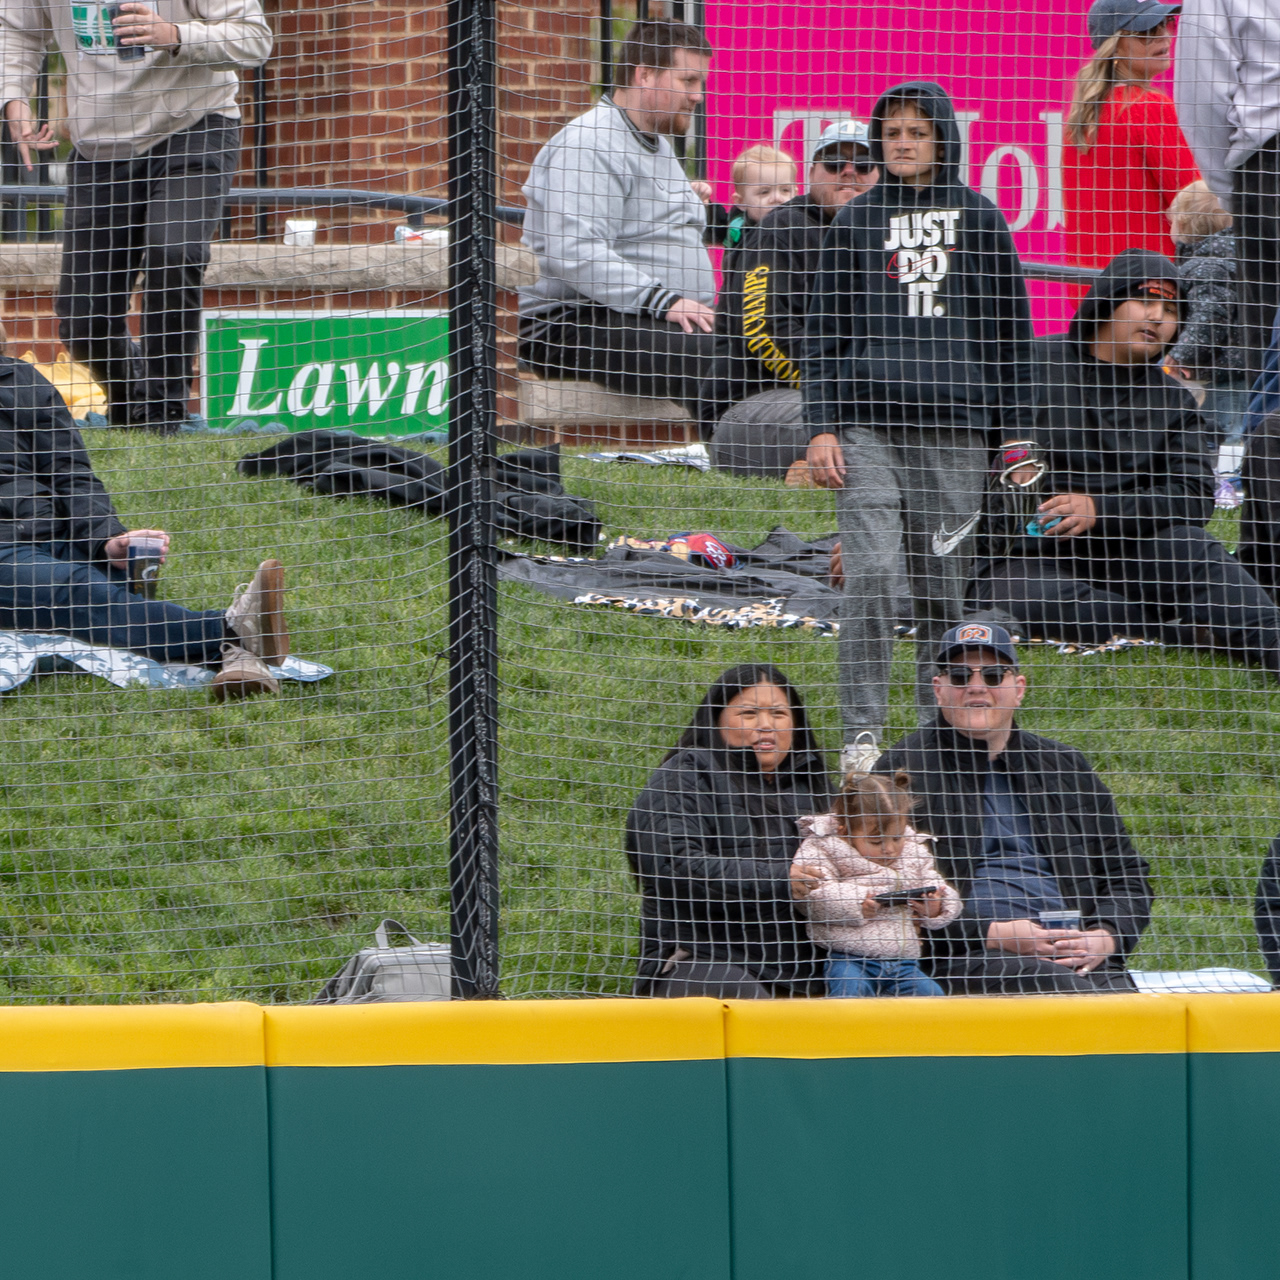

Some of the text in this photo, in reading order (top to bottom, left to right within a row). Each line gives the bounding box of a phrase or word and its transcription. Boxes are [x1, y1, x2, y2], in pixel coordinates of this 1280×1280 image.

[884, 210, 960, 250] JUST
[897, 246, 948, 284] DO
[908, 282, 944, 317] IT.
[226, 338, 450, 417] Lawn
